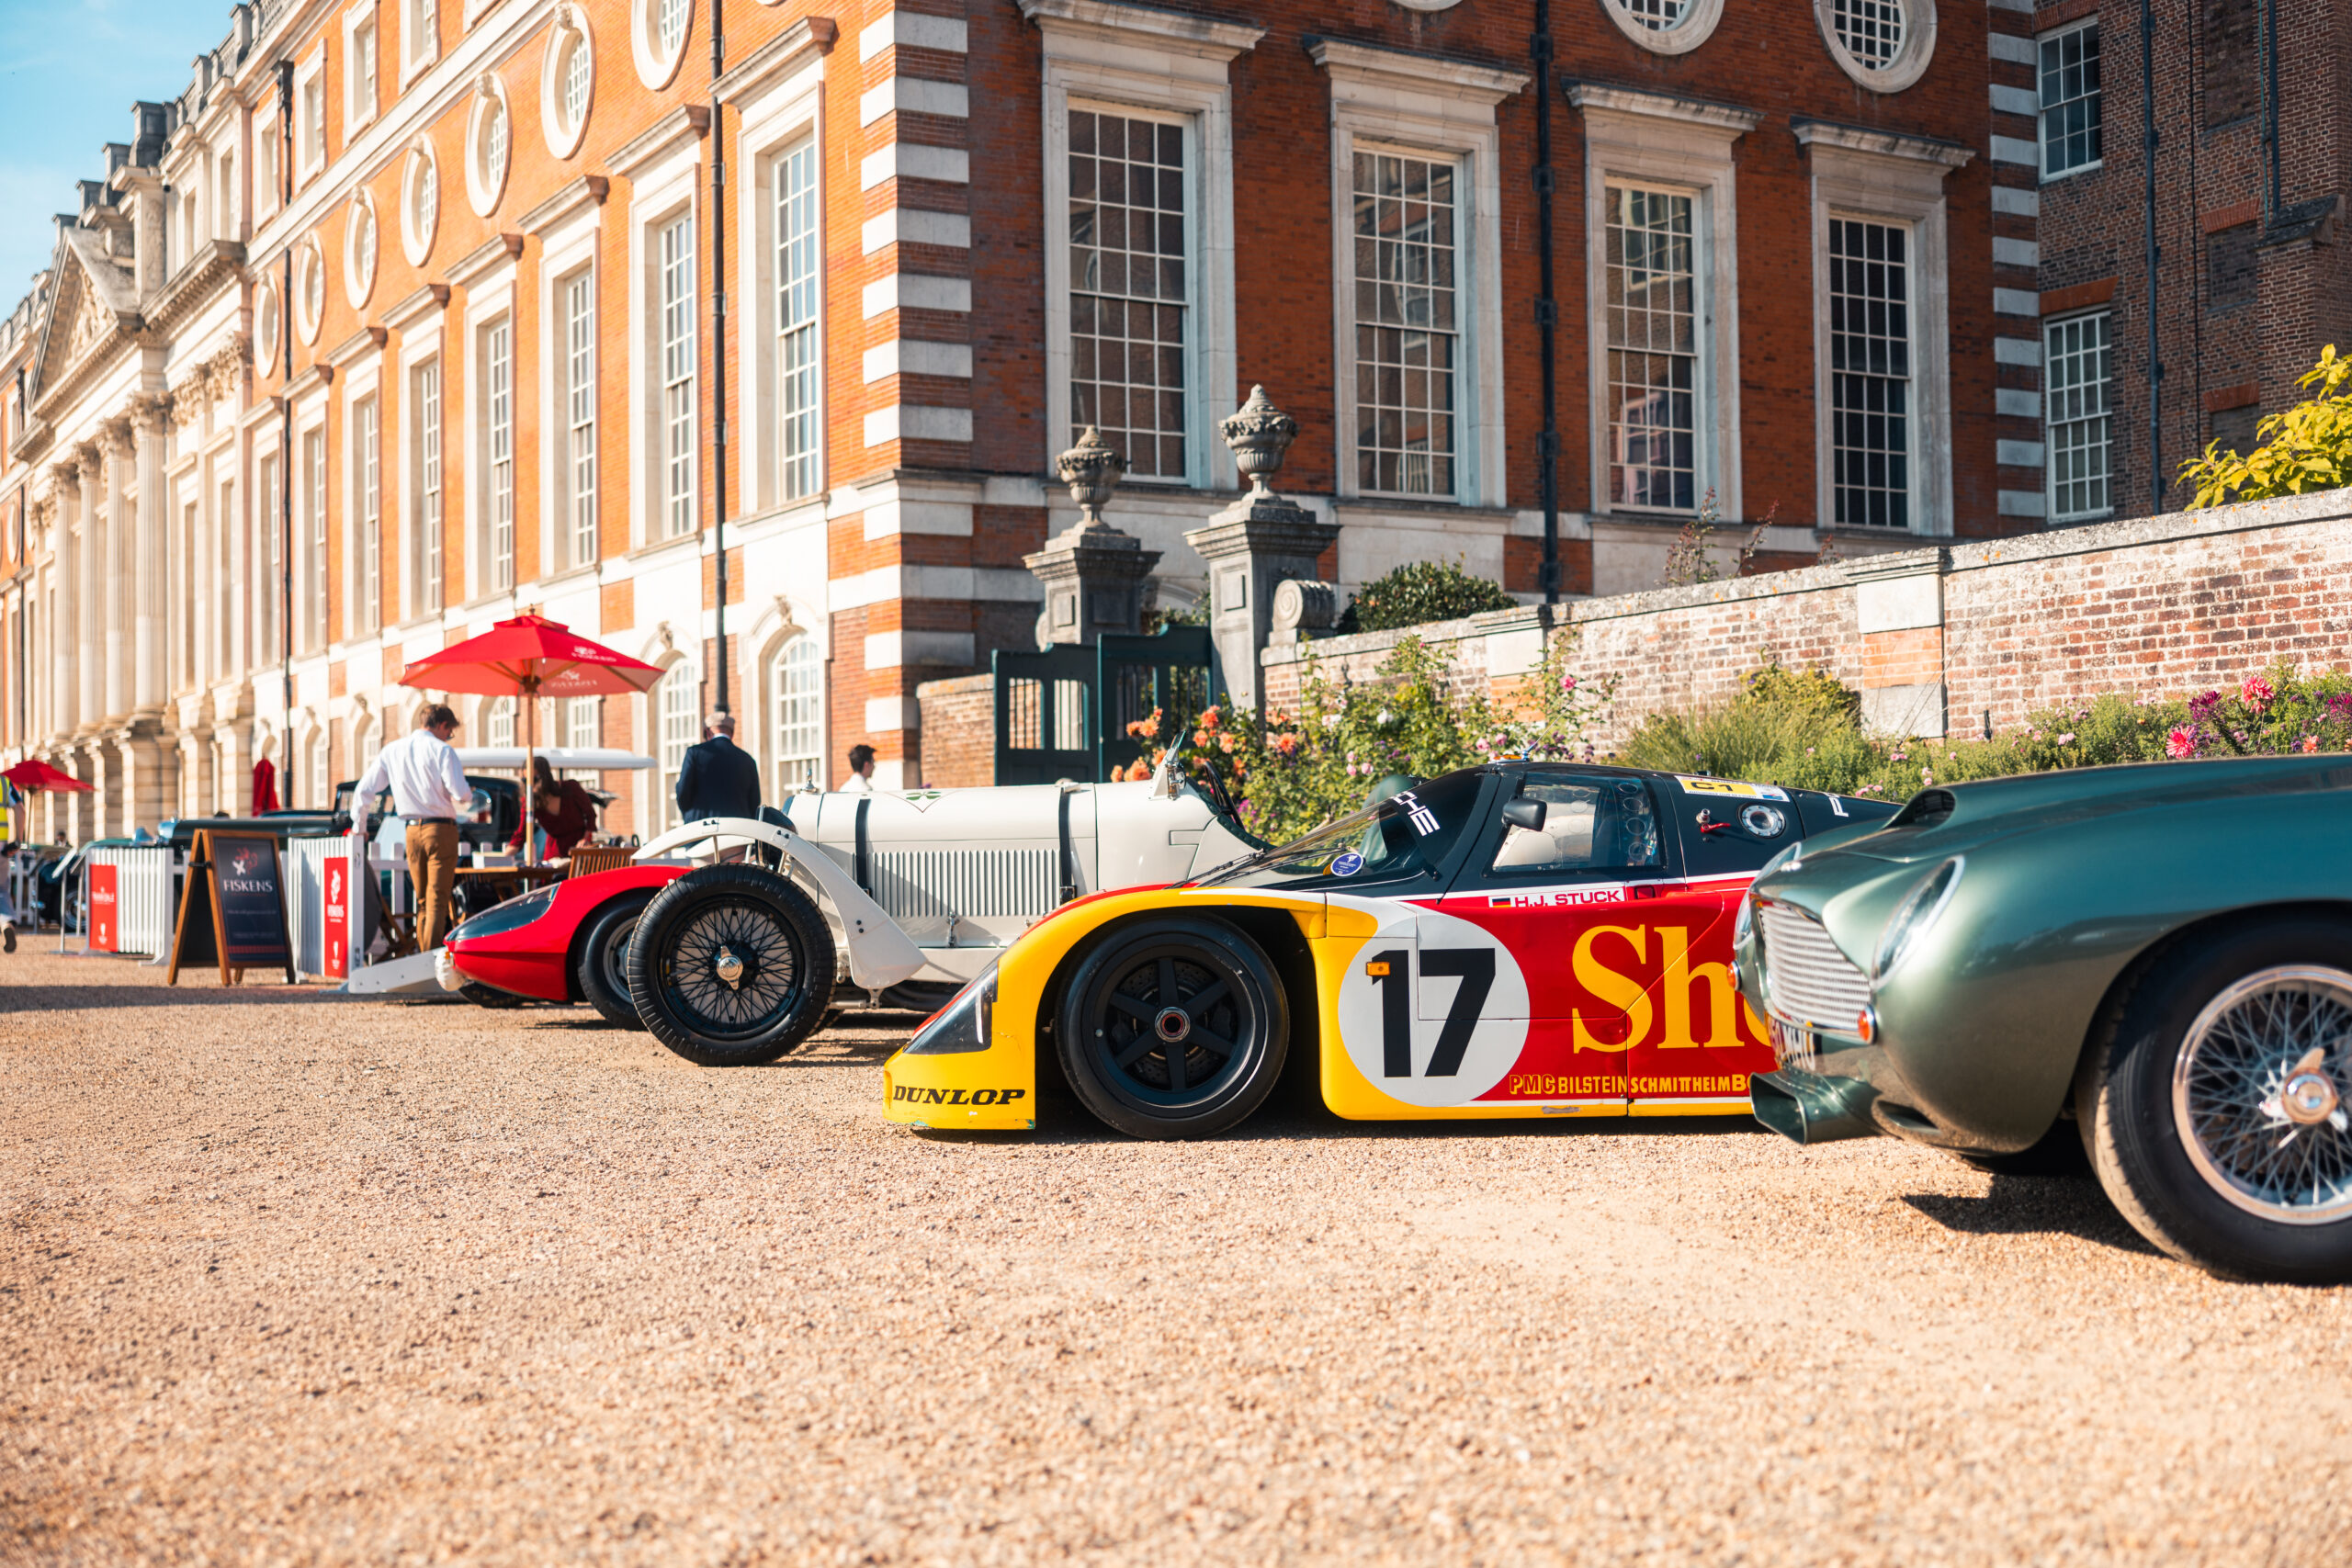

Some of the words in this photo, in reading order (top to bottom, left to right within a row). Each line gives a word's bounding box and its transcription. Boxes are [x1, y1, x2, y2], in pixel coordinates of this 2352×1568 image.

[1690, 782, 1734, 792] C1
[223, 879, 273, 893] FISKENS
[1515, 895, 1548, 908] H.J.
[1555, 890, 1623, 906] STUCK
[1372, 948, 1496, 1078] 17
[1510, 1074, 1555, 1095] PMC
[1558, 1075, 1627, 1094] BILSTEIN
[1732, 1074, 1751, 1093] B
[893, 1085, 1026, 1106] DUNLOP
